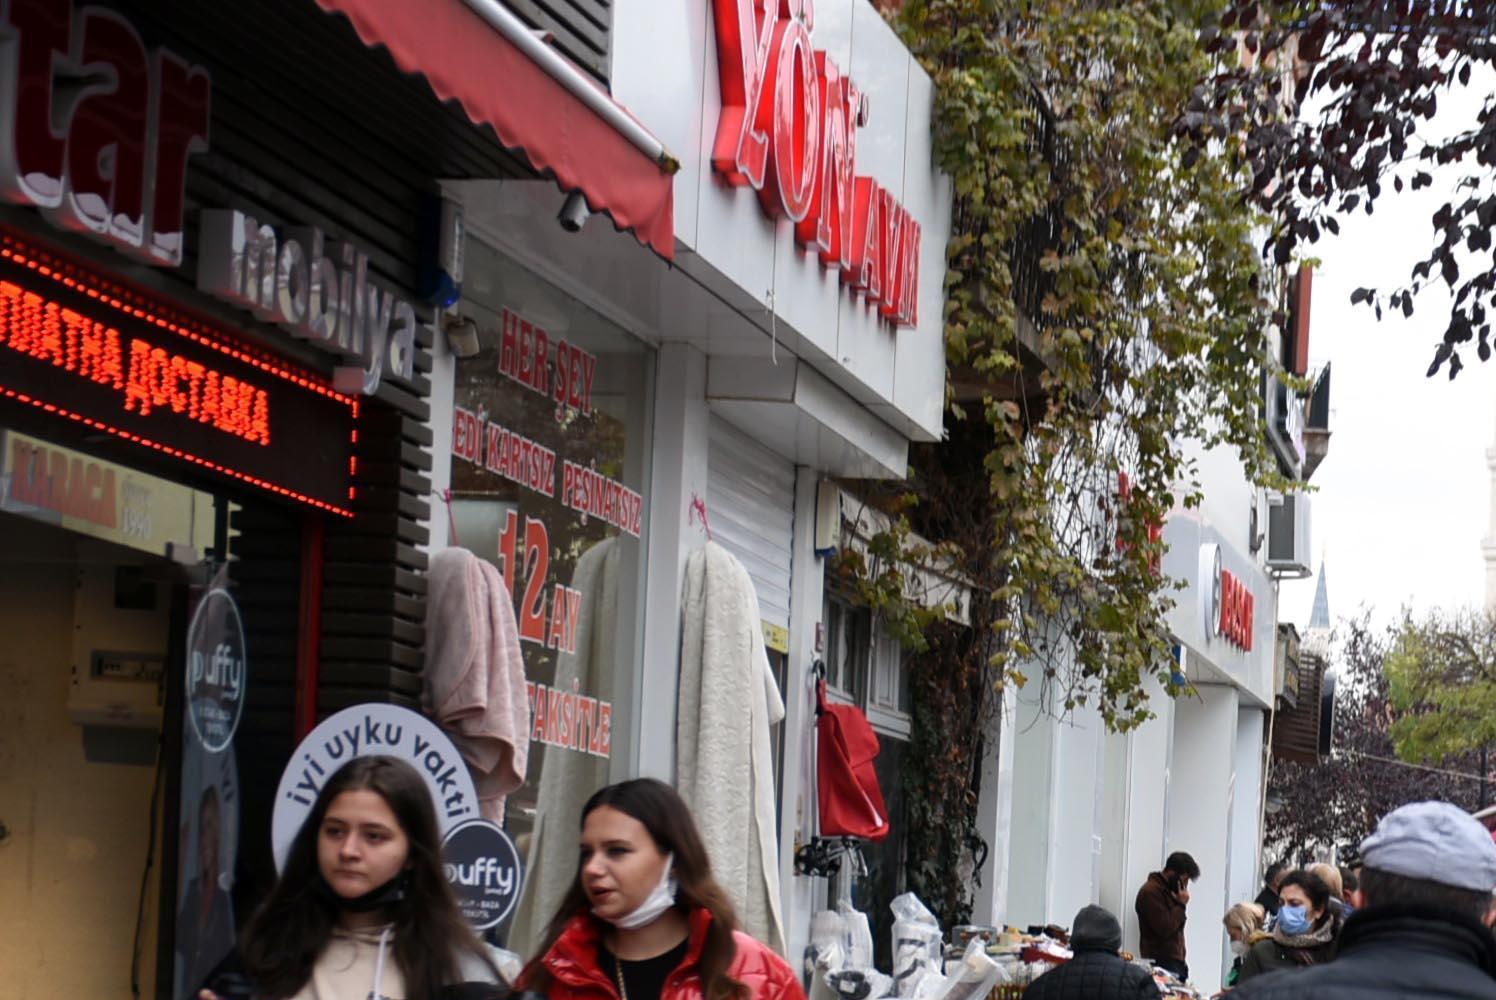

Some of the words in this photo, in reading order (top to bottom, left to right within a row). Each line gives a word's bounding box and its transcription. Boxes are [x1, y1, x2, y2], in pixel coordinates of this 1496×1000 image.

[728, 0, 861, 270] YÖN
[857, 176, 922, 330] AVM
[228, 209, 416, 395] mobilya
[123, 339, 271, 447] ДОСТАВКА
[498, 306, 550, 396] HER
[553, 338, 596, 422] ŞEY
[486, 421, 556, 498] KARTSIZ
[562, 457, 642, 538] PEŞİNATSIZ
[498, 508, 550, 647] 12
[548, 584, 582, 654] AY
[191, 643, 241, 701] puffy
[286, 754, 326, 808] iyi
[324, 715, 402, 762] uyku
[412, 734, 472, 818] vakti
